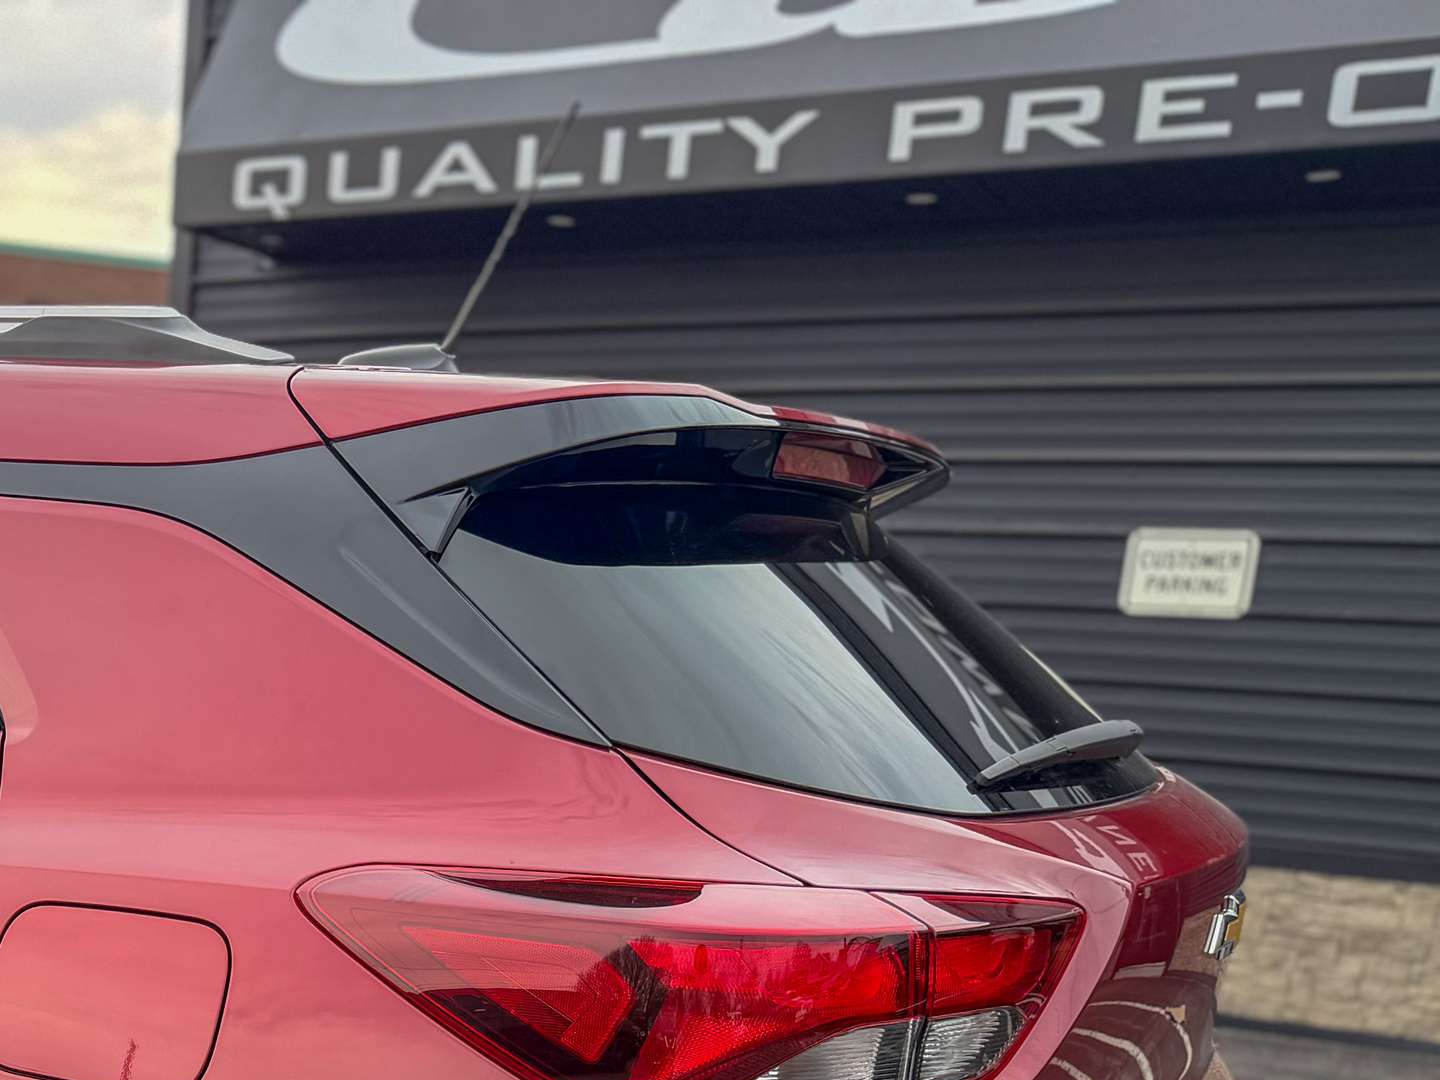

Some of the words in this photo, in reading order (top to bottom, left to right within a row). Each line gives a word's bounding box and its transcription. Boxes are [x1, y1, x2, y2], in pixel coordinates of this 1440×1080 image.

[231, 108, 821, 220] QUALITY
[1140, 551, 1243, 571] CUSTOMER
[1143, 574, 1230, 598] PARKING
